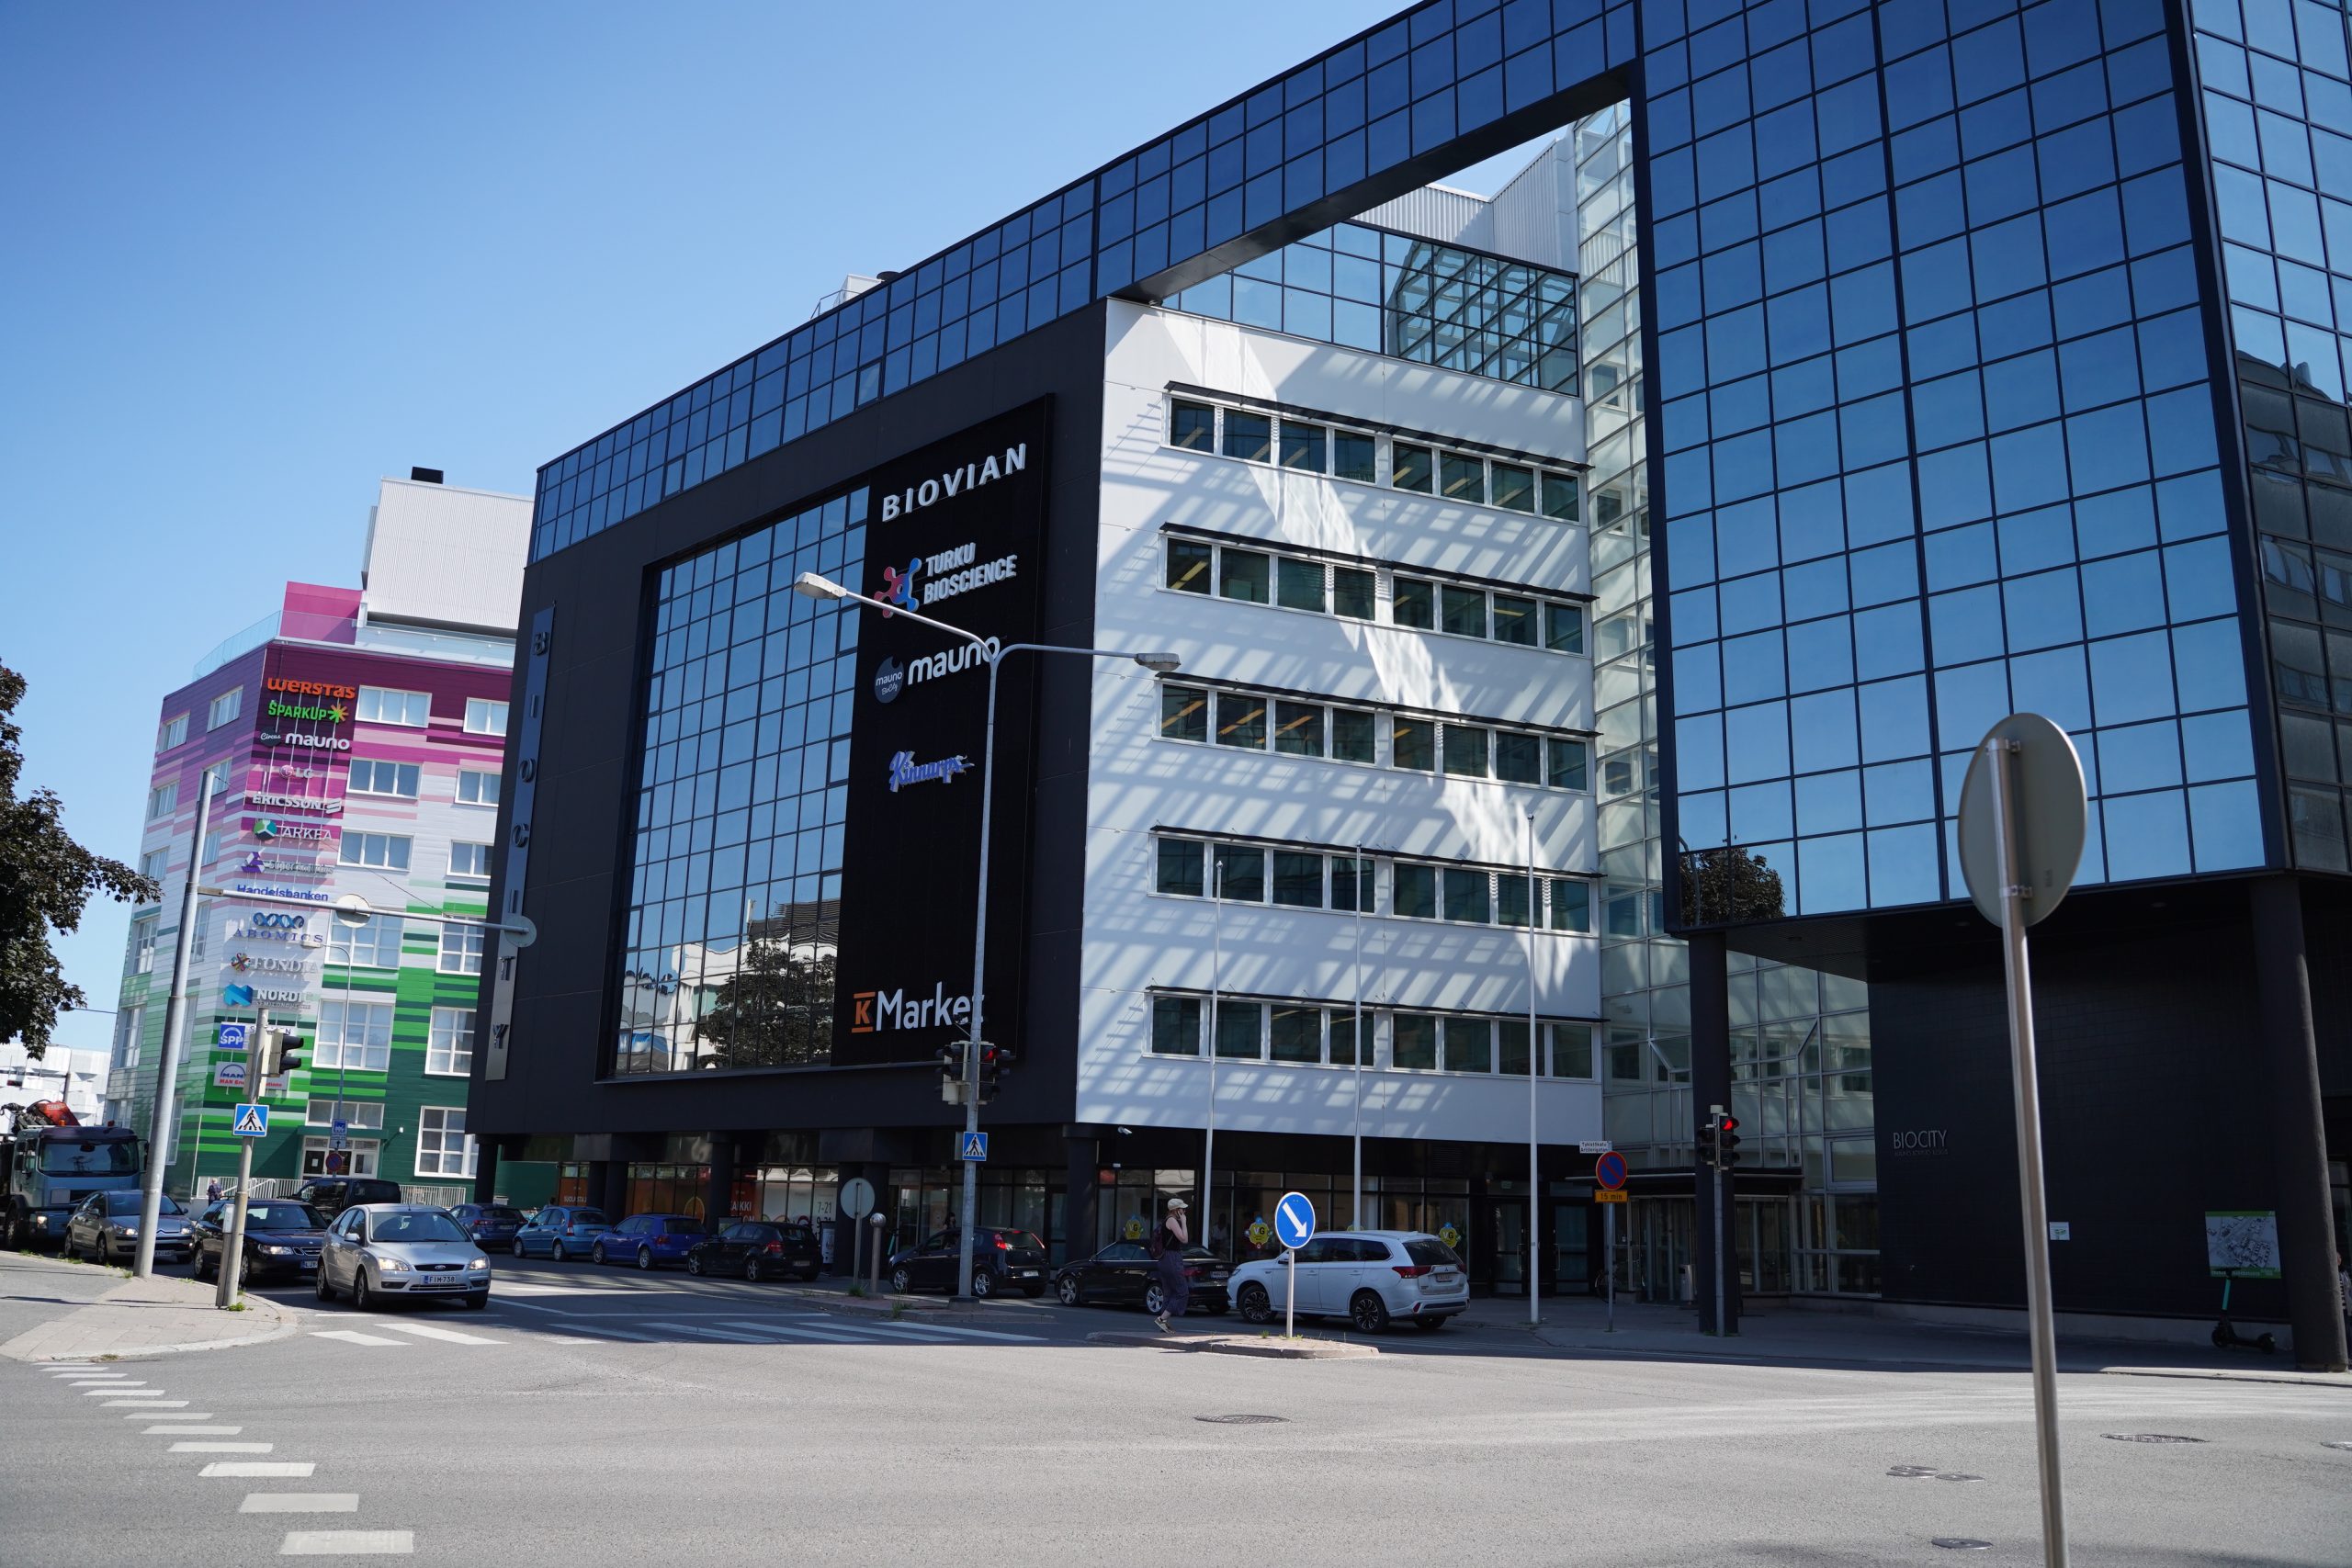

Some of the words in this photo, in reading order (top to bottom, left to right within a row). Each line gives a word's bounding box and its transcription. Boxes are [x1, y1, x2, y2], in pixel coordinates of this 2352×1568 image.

[882, 443, 1027, 523] BIOVIAN
[926, 542, 977, 577] TURKU
[923, 554, 1018, 604] BIOSCIENCE
[908, 636, 1001, 686] mauno
[876, 671, 903, 686] mauno
[260, 732, 282, 740] Circus
[285, 732, 350, 750] mauno
[295, 767, 314, 779] LG
[253, 795, 322, 810] ERICSSON
[236, 884, 329, 901] Handelsbanken
[233, 928, 323, 943] ABOMICS
[253, 956, 320, 973] FONDIA
[220, 1035, 244, 1045] SPP
[1893, 1129, 1948, 1149] BIOCITY
[817, 1201, 832, 1213] 7-21
